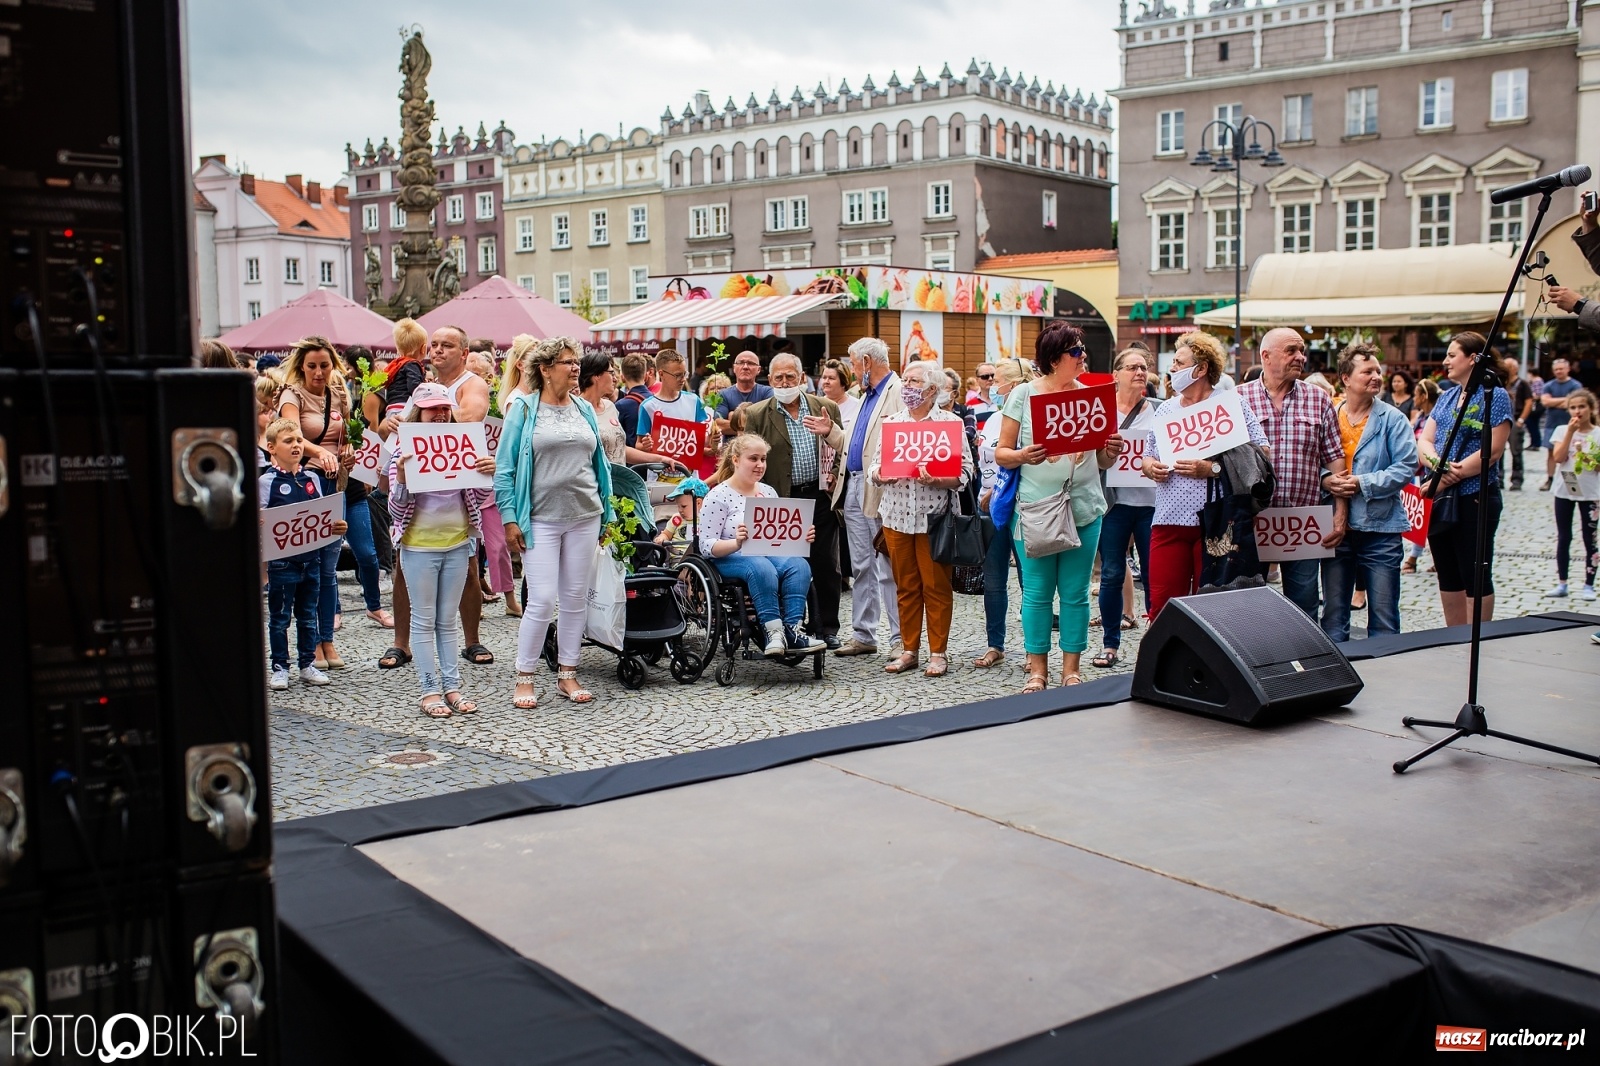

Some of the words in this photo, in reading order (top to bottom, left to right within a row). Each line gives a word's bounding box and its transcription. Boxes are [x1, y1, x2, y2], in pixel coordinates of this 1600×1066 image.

[1045, 397, 1106, 422] DUDA
[1045, 413, 1107, 440] 2020
[1166, 404, 1230, 438] DUDA
[412, 433, 475, 456] DUDA
[660, 425, 697, 445] DUDA
[895, 430, 951, 447] DUDA
[1170, 418, 1234, 453] 2020
[656, 438, 697, 457] 2020
[893, 445, 952, 462] 2020
[417, 451, 478, 473] 2020
[272, 509, 332, 536] 2020
[753, 506, 802, 524] DUDA
[1256, 515, 1321, 532] DUDA
[274, 523, 333, 550] DUDA
[752, 523, 802, 540] 2020
[1257, 530, 1322, 546] 2020
